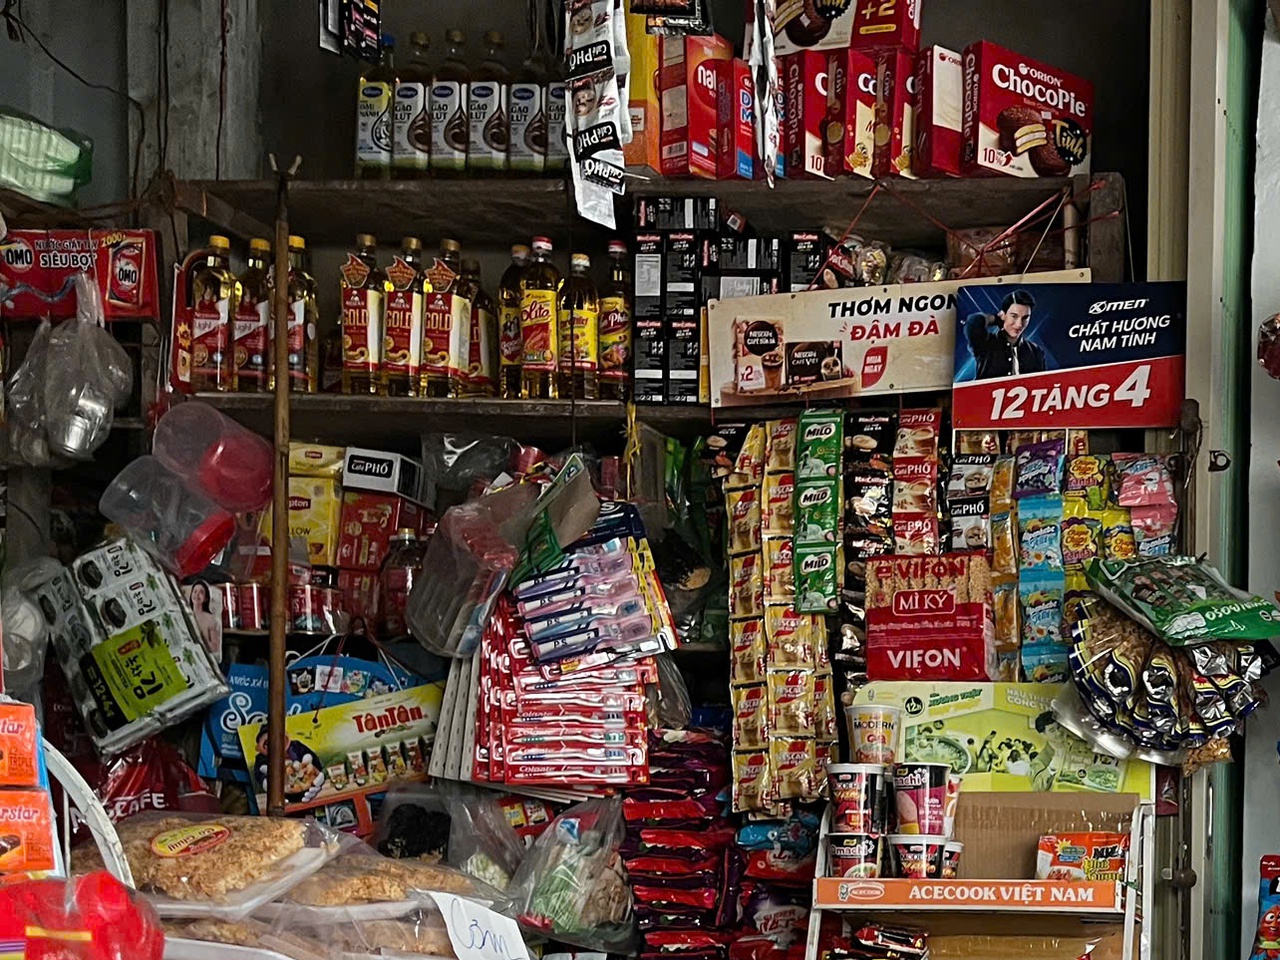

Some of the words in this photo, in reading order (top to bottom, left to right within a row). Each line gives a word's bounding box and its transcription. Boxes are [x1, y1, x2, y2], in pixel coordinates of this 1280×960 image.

[1028, 65, 1064, 86] ORION
[6, 248, 33, 266] OMO
[118, 268, 137, 282] OMO
[829, 296, 893, 319] THƠM
[425, 312, 451, 331] GOLD
[850, 320, 901, 345] ĐẬM
[907, 315, 939, 337] ĐÀ
[1068, 321, 1103, 338] CHẤT
[1112, 314, 1171, 336] HƯƠNG
[1079, 336, 1118, 352] NAM
[1120, 331, 1156, 348] TÍNH
[990, 387, 1026, 421] 12
[1030, 383, 1110, 417] TẶNG
[1113, 365, 1152, 407] 4
[805, 426, 834, 439] MILO
[801, 490, 830, 504] MILO
[804, 557, 830, 571] MILO
[887, 649, 961, 669] VIFON
[909, 886, 996, 900] ACECOOK
[1000, 884, 1045, 904] VIỆT
[1050, 888, 1094, 902] NAM
